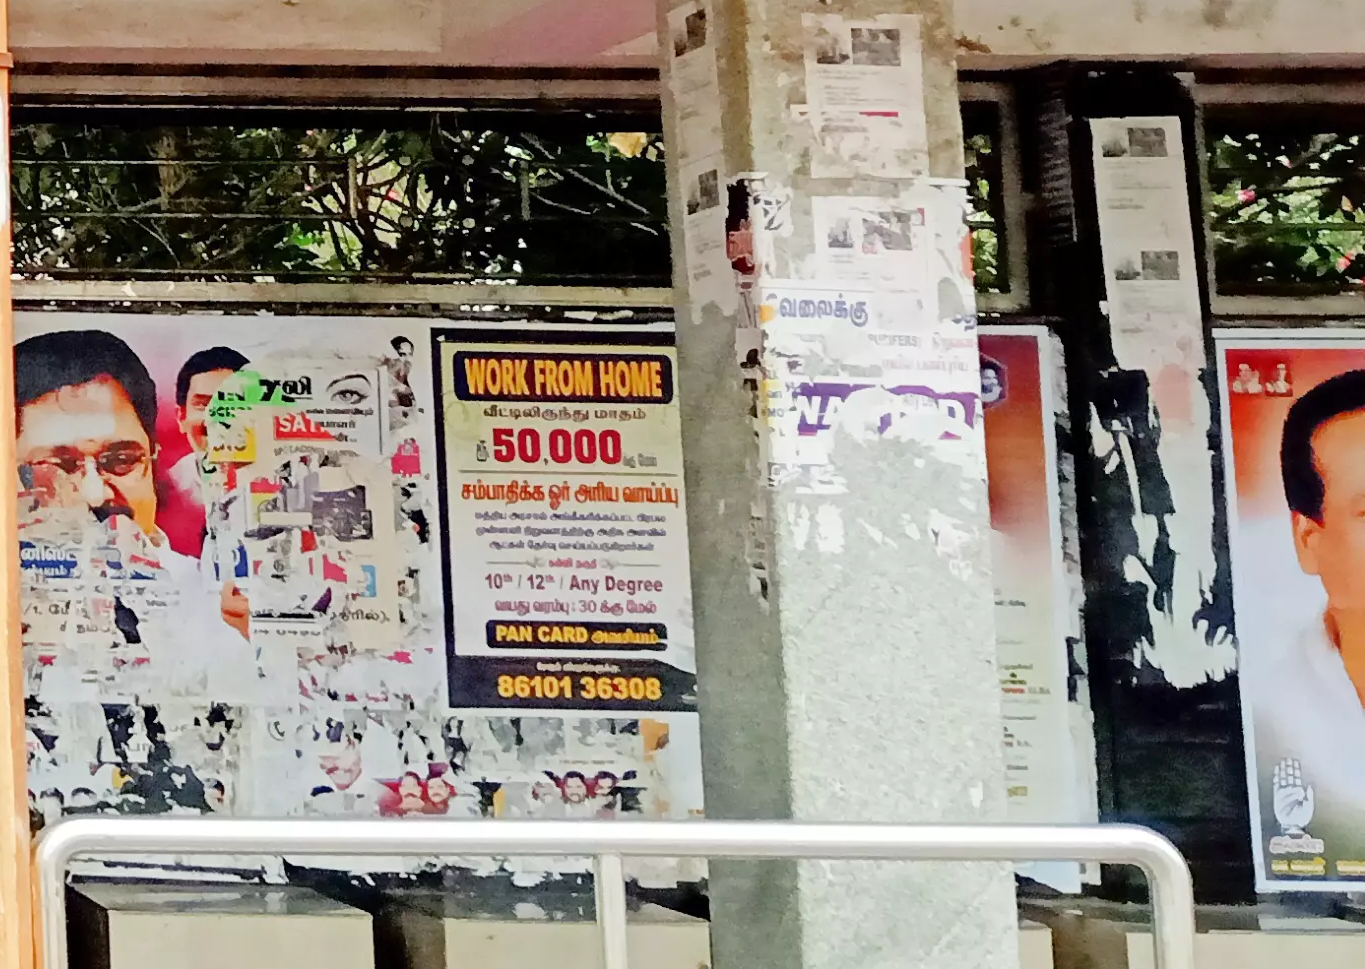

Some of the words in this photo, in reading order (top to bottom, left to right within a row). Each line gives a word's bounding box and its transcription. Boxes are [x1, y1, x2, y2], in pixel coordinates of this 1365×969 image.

[464, 357, 530, 396] WORK
[533, 359, 594, 397] FROM
[598, 360, 663, 398] HOME
[483, 404, 590, 423] வீட்டிலிருந்து
[594, 407, 647, 422] மாதம்
[492, 427, 622, 466] 50,000
[461, 478, 545, 508] சம்பாதிக்க
[569, 574, 600, 596] Any
[605, 575, 664, 596] Degree
[578, 599, 598, 614] 30
[495, 624, 534, 643] PAN
[537, 626, 589, 644] CARD
[497, 674, 573, 700] 86101
[579, 676, 663, 701] 36308
